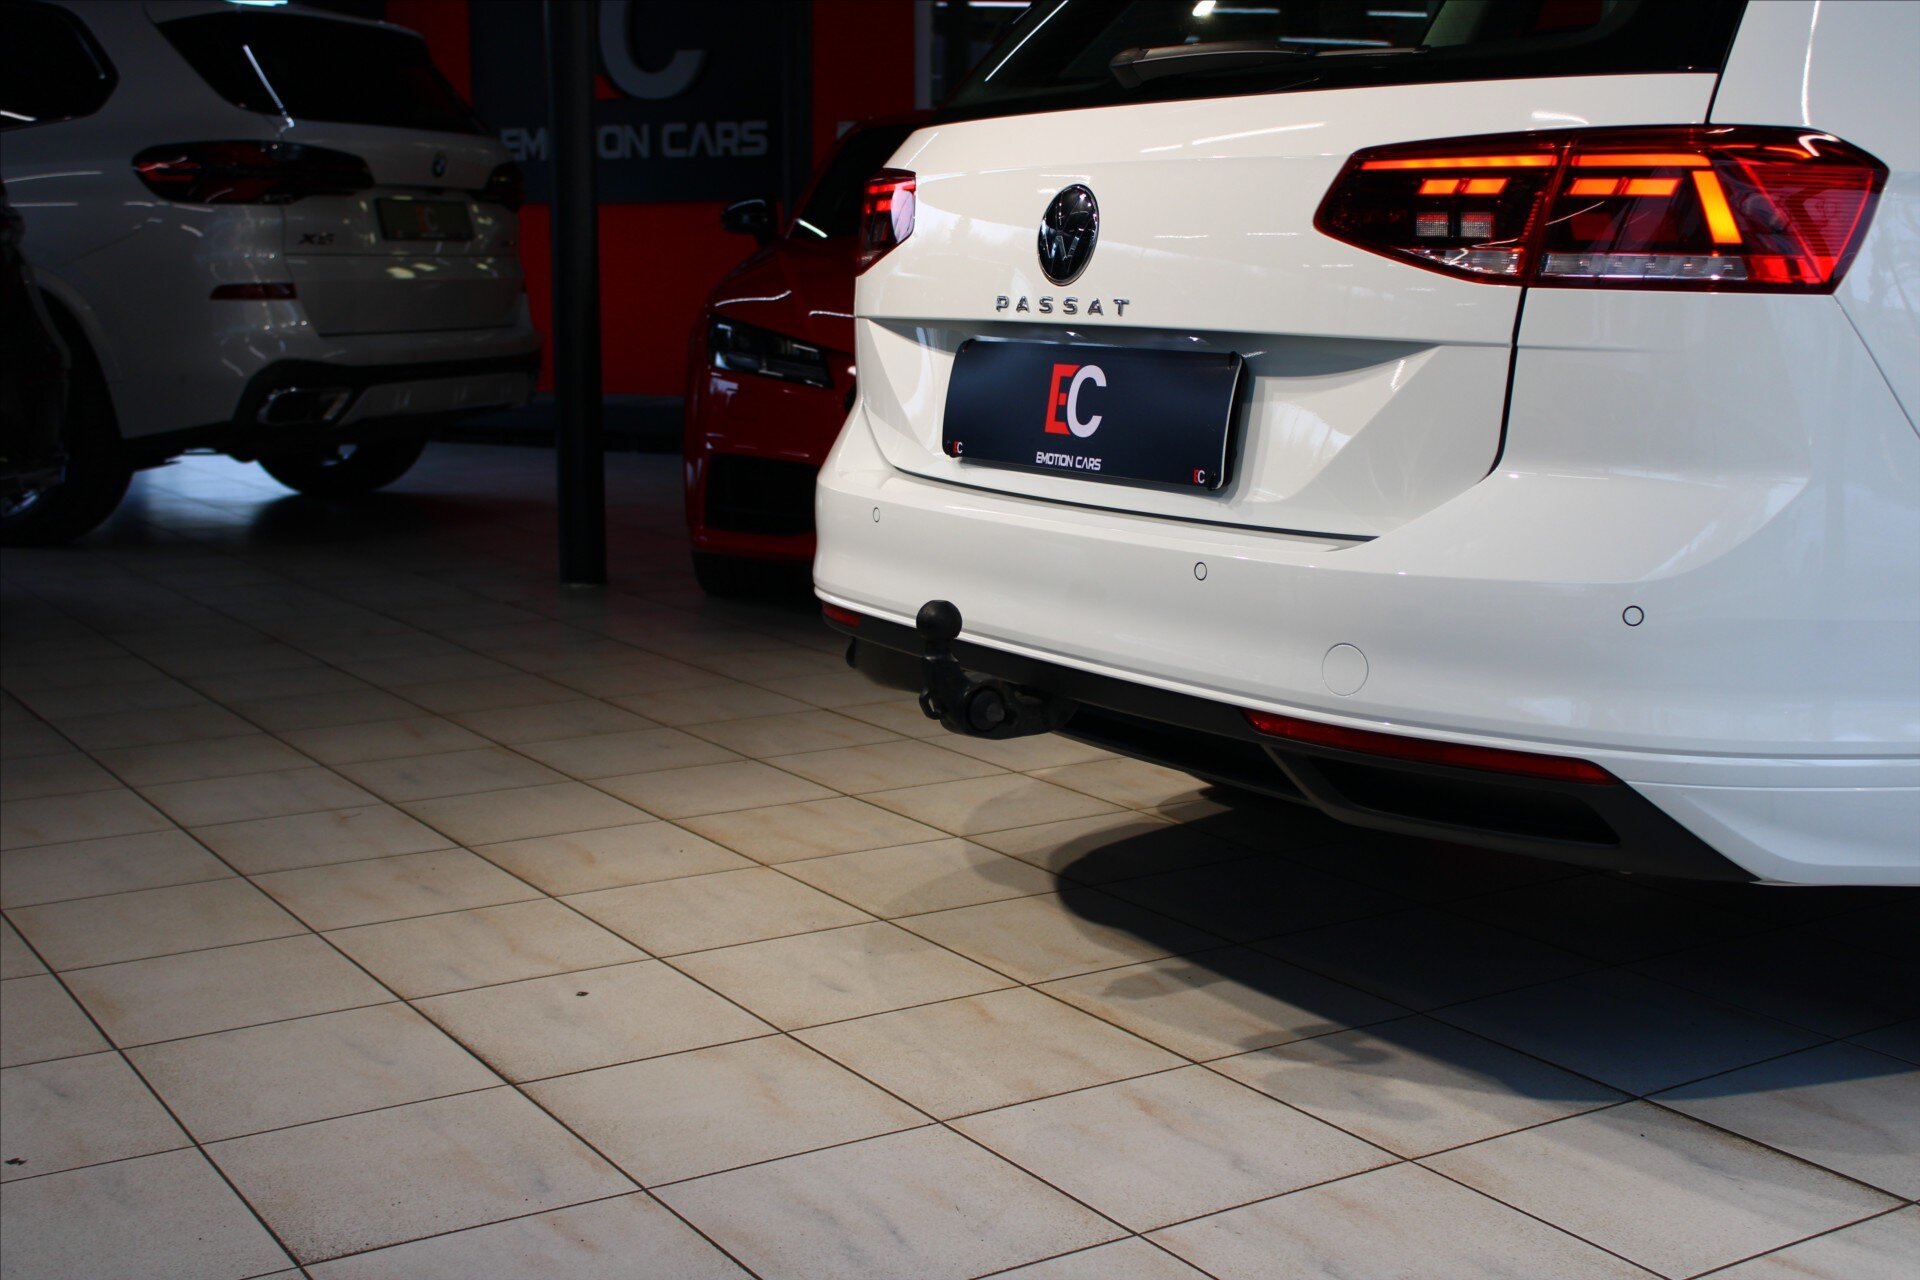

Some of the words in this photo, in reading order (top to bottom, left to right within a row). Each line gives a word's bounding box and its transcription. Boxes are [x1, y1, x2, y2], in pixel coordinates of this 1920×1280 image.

[500, 121, 651, 161] EMON
[660, 120, 768, 158] CARS
[996, 295, 1129, 316] PASSAT
[1044, 363, 1107, 438] EC
[1035, 451, 1074, 468] EMOTION
[1075, 456, 1102, 471] CARS
